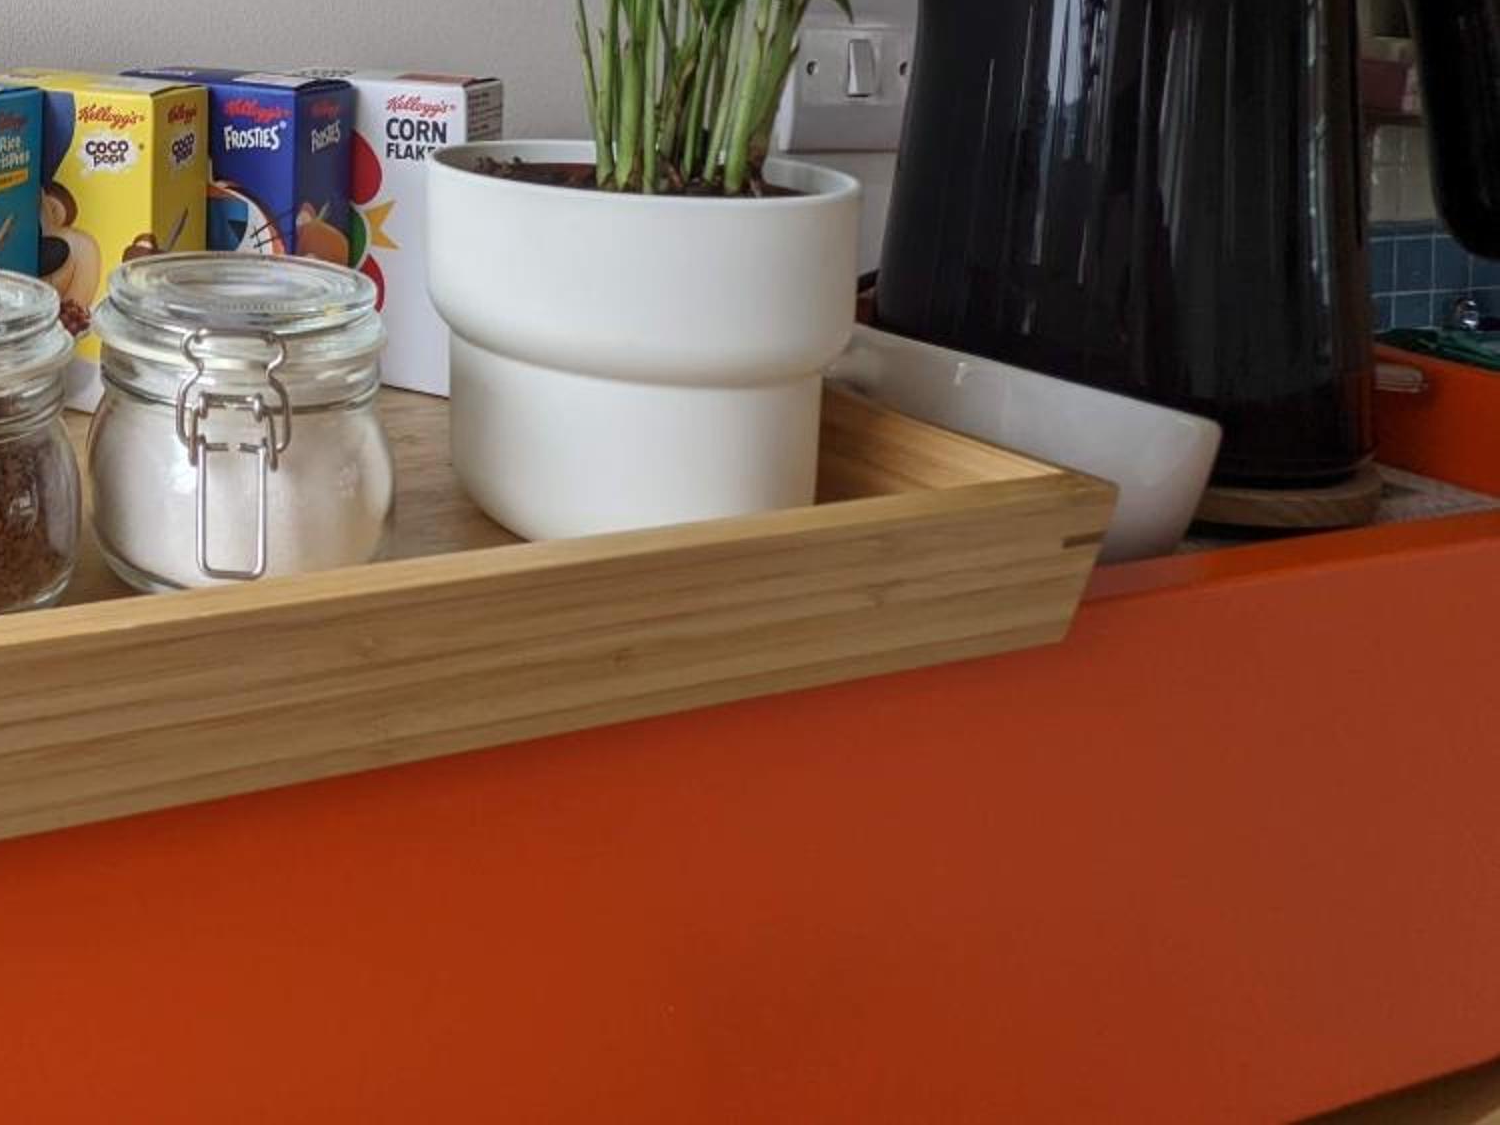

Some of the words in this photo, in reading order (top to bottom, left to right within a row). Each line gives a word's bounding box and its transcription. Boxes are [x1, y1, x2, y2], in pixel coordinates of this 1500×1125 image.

[78, 104, 137, 129] Kellogg's
[386, 94, 448, 118] Kellogg's
[224, 125, 279, 150] FROSTIES
[386, 118, 447, 143] CORN
[386, 142, 437, 160] FLAK
